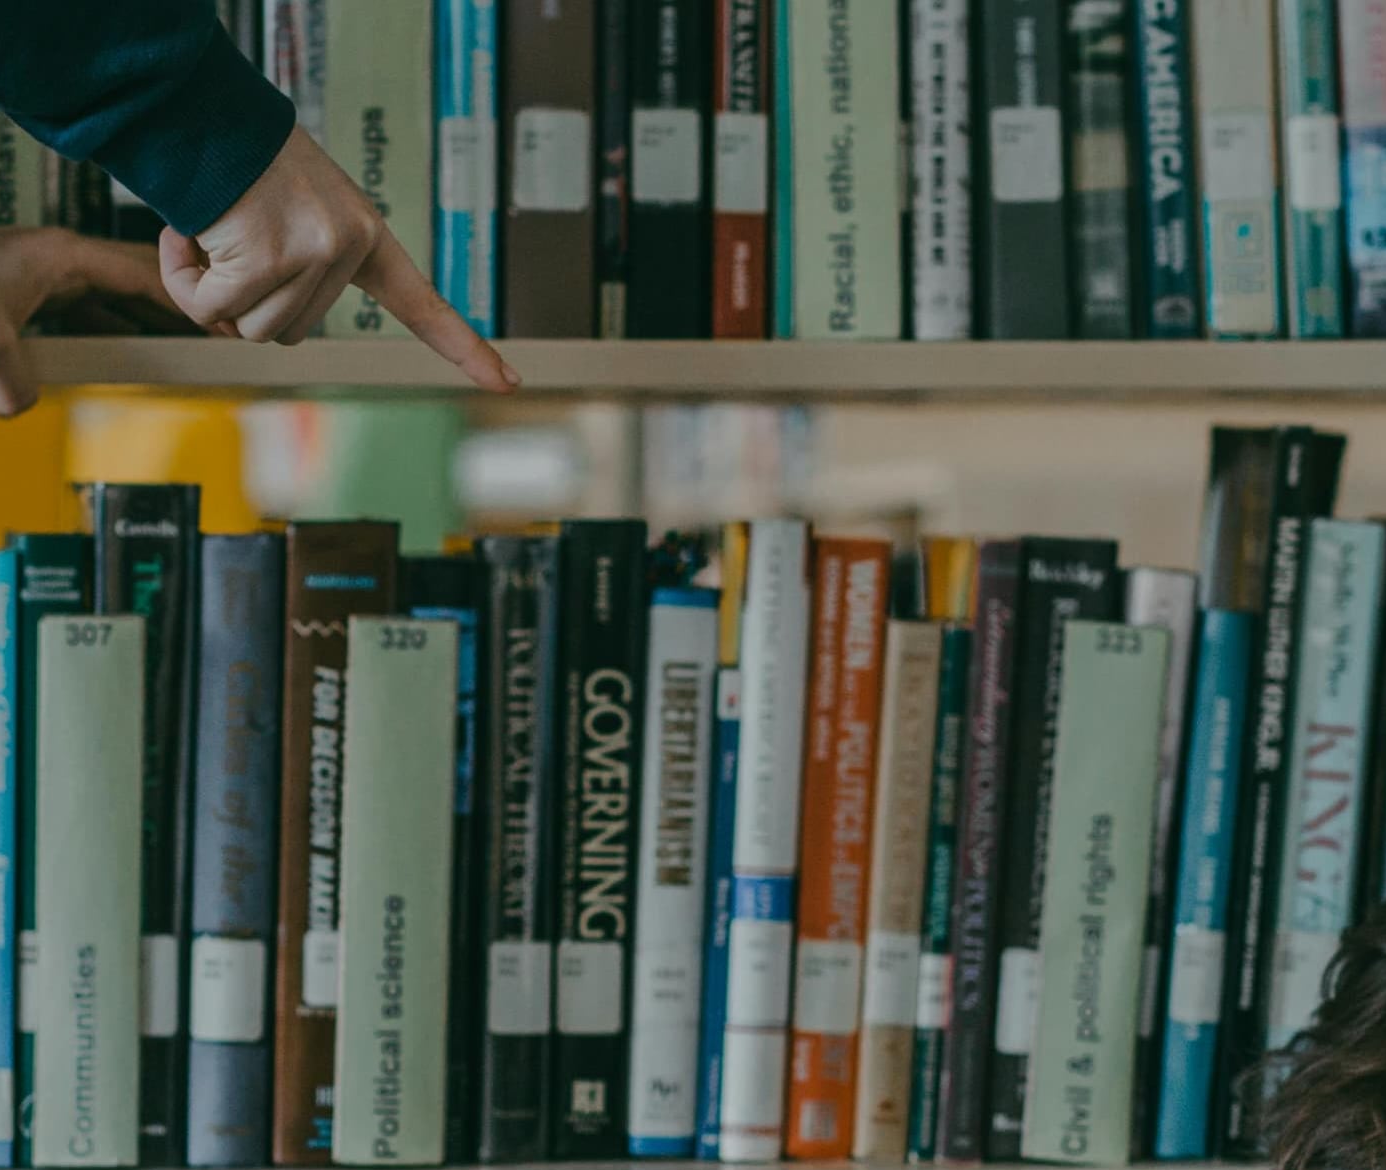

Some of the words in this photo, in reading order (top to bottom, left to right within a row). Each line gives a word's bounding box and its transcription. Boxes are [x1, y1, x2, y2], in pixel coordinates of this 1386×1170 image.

[827, 126, 855, 214] ethic,
[1144, 25, 1184, 200] AMERICA
[829, 225, 855, 333] Racial,
[65, 622, 114, 649] 307
[379, 625, 428, 652] 320
[845, 558, 878, 671] WOMEN
[313, 667, 340, 721] FOR
[310, 728, 338, 847] DECISION
[579, 668, 633, 940] GOVERNING
[655, 660, 700, 888] LIBERTARIANISM
[833, 720, 871, 843] POLITICS
[1085, 813, 1116, 906] rights
[379, 895, 405, 1020] science
[1074, 913, 1104, 1044] political
[66, 944, 98, 1157] Communities
[374, 1028, 403, 1158] Political
[1061, 1085, 1094, 1156] Civil
